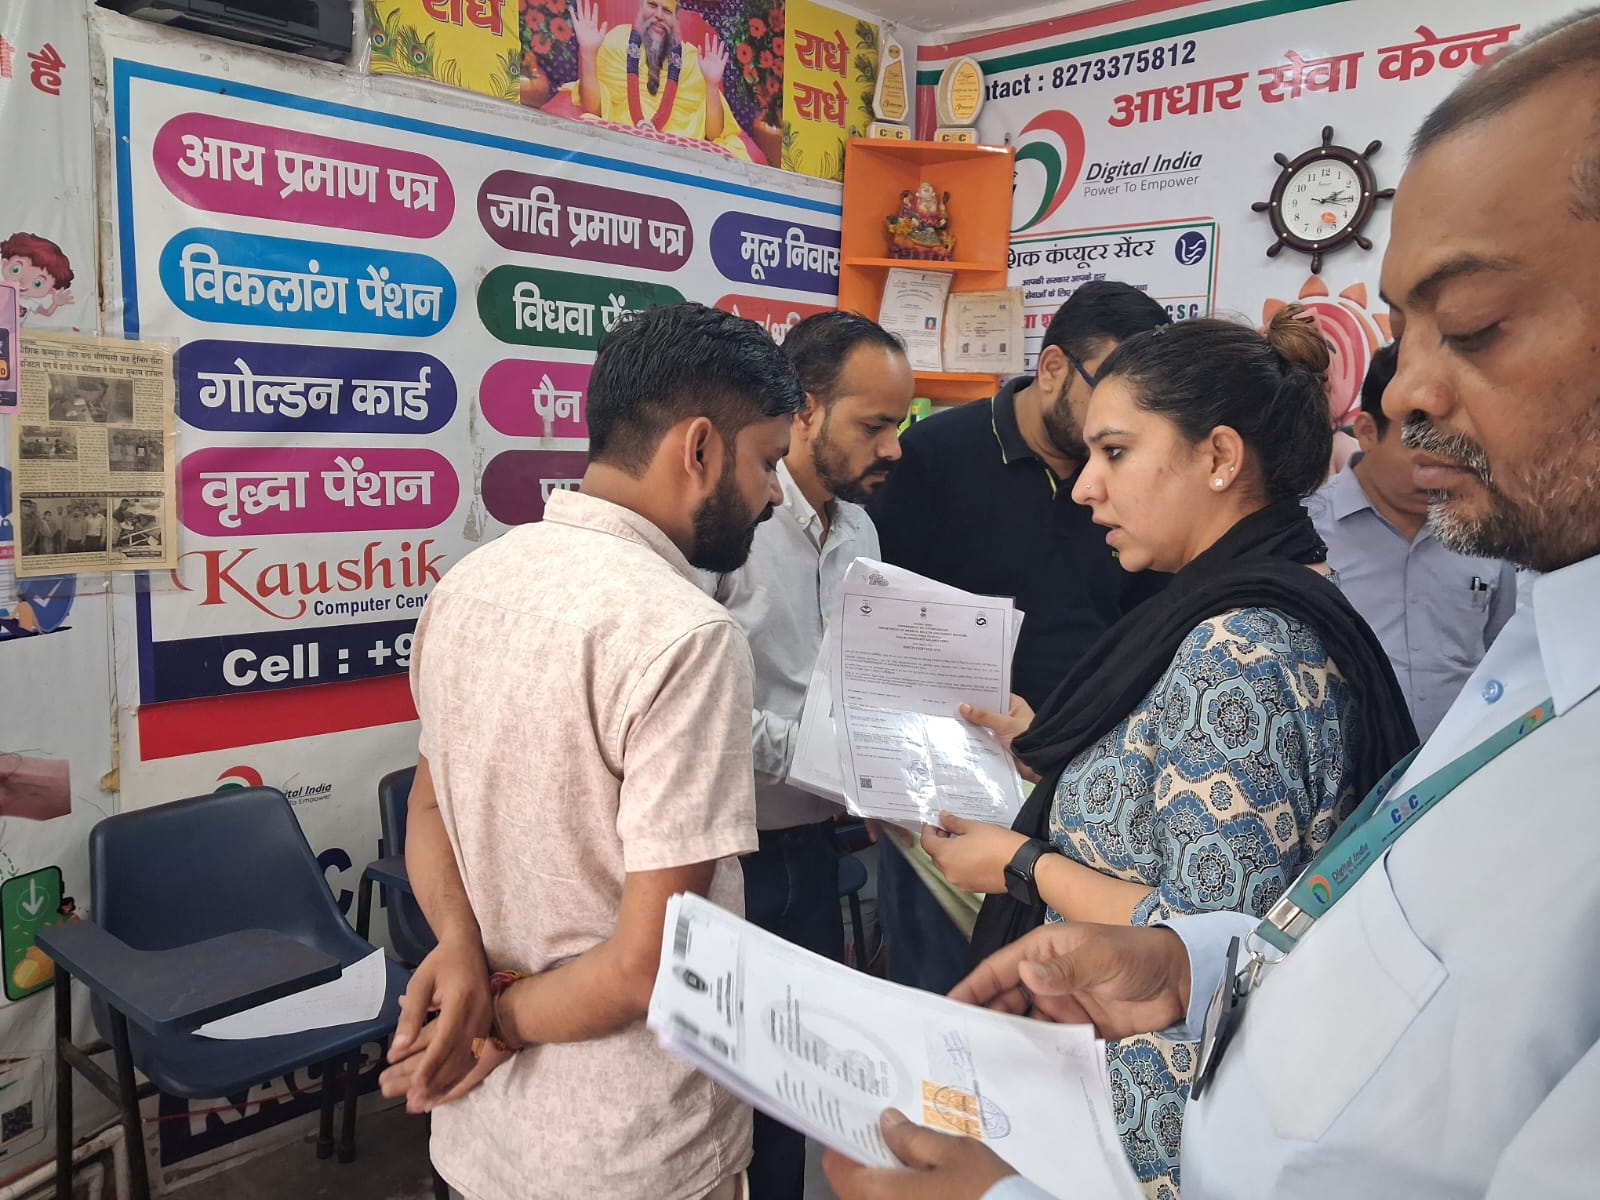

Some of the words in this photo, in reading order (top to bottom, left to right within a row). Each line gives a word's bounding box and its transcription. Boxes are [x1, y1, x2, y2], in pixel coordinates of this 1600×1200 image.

[421, 0, 504, 36] राध
[794, 29, 851, 79] राधे
[1052, 40, 1196, 89] 8273375812
[793, 80, 848, 129] राधे
[1108, 73, 1249, 128] आधार
[1258, 49, 1364, 104] सेवा
[177, 134, 264, 186] आय
[275, 148, 379, 203] प्रमाण
[387, 168, 438, 212] पत्र
[1084, 185, 1119, 197] Power
[1124, 182, 1137, 193] To
[1140, 174, 1200, 191] Empower
[1085, 156, 1150, 183] Digital
[1152, 150, 1203, 173] India
[486, 185, 561, 238] जाति
[567, 204, 641, 248] प्रमाण
[649, 222, 686, 258] पत्र
[740, 231, 782, 280] मूल
[1046, 243, 1109, 269] कंप्यूटर
[1113, 236, 1156, 258] सेंटर
[179, 242, 348, 315] विकलांग
[357, 264, 443, 322] पेंशन
[512, 281, 595, 337] विधवा
[197, 357, 343, 419] गोल्डन
[351, 366, 431, 421] कार्ड
[532, 374, 582, 423] पैन
[200, 471, 309, 528] वृद्धा
[321, 455, 435, 508] पेंशन
[171, 539, 448, 620] Kaushik
[313, 597, 391, 616] Computer
[222, 642, 319, 687] Cell
[367, 633, 414, 667] +9
[305, 783, 332, 796] India
